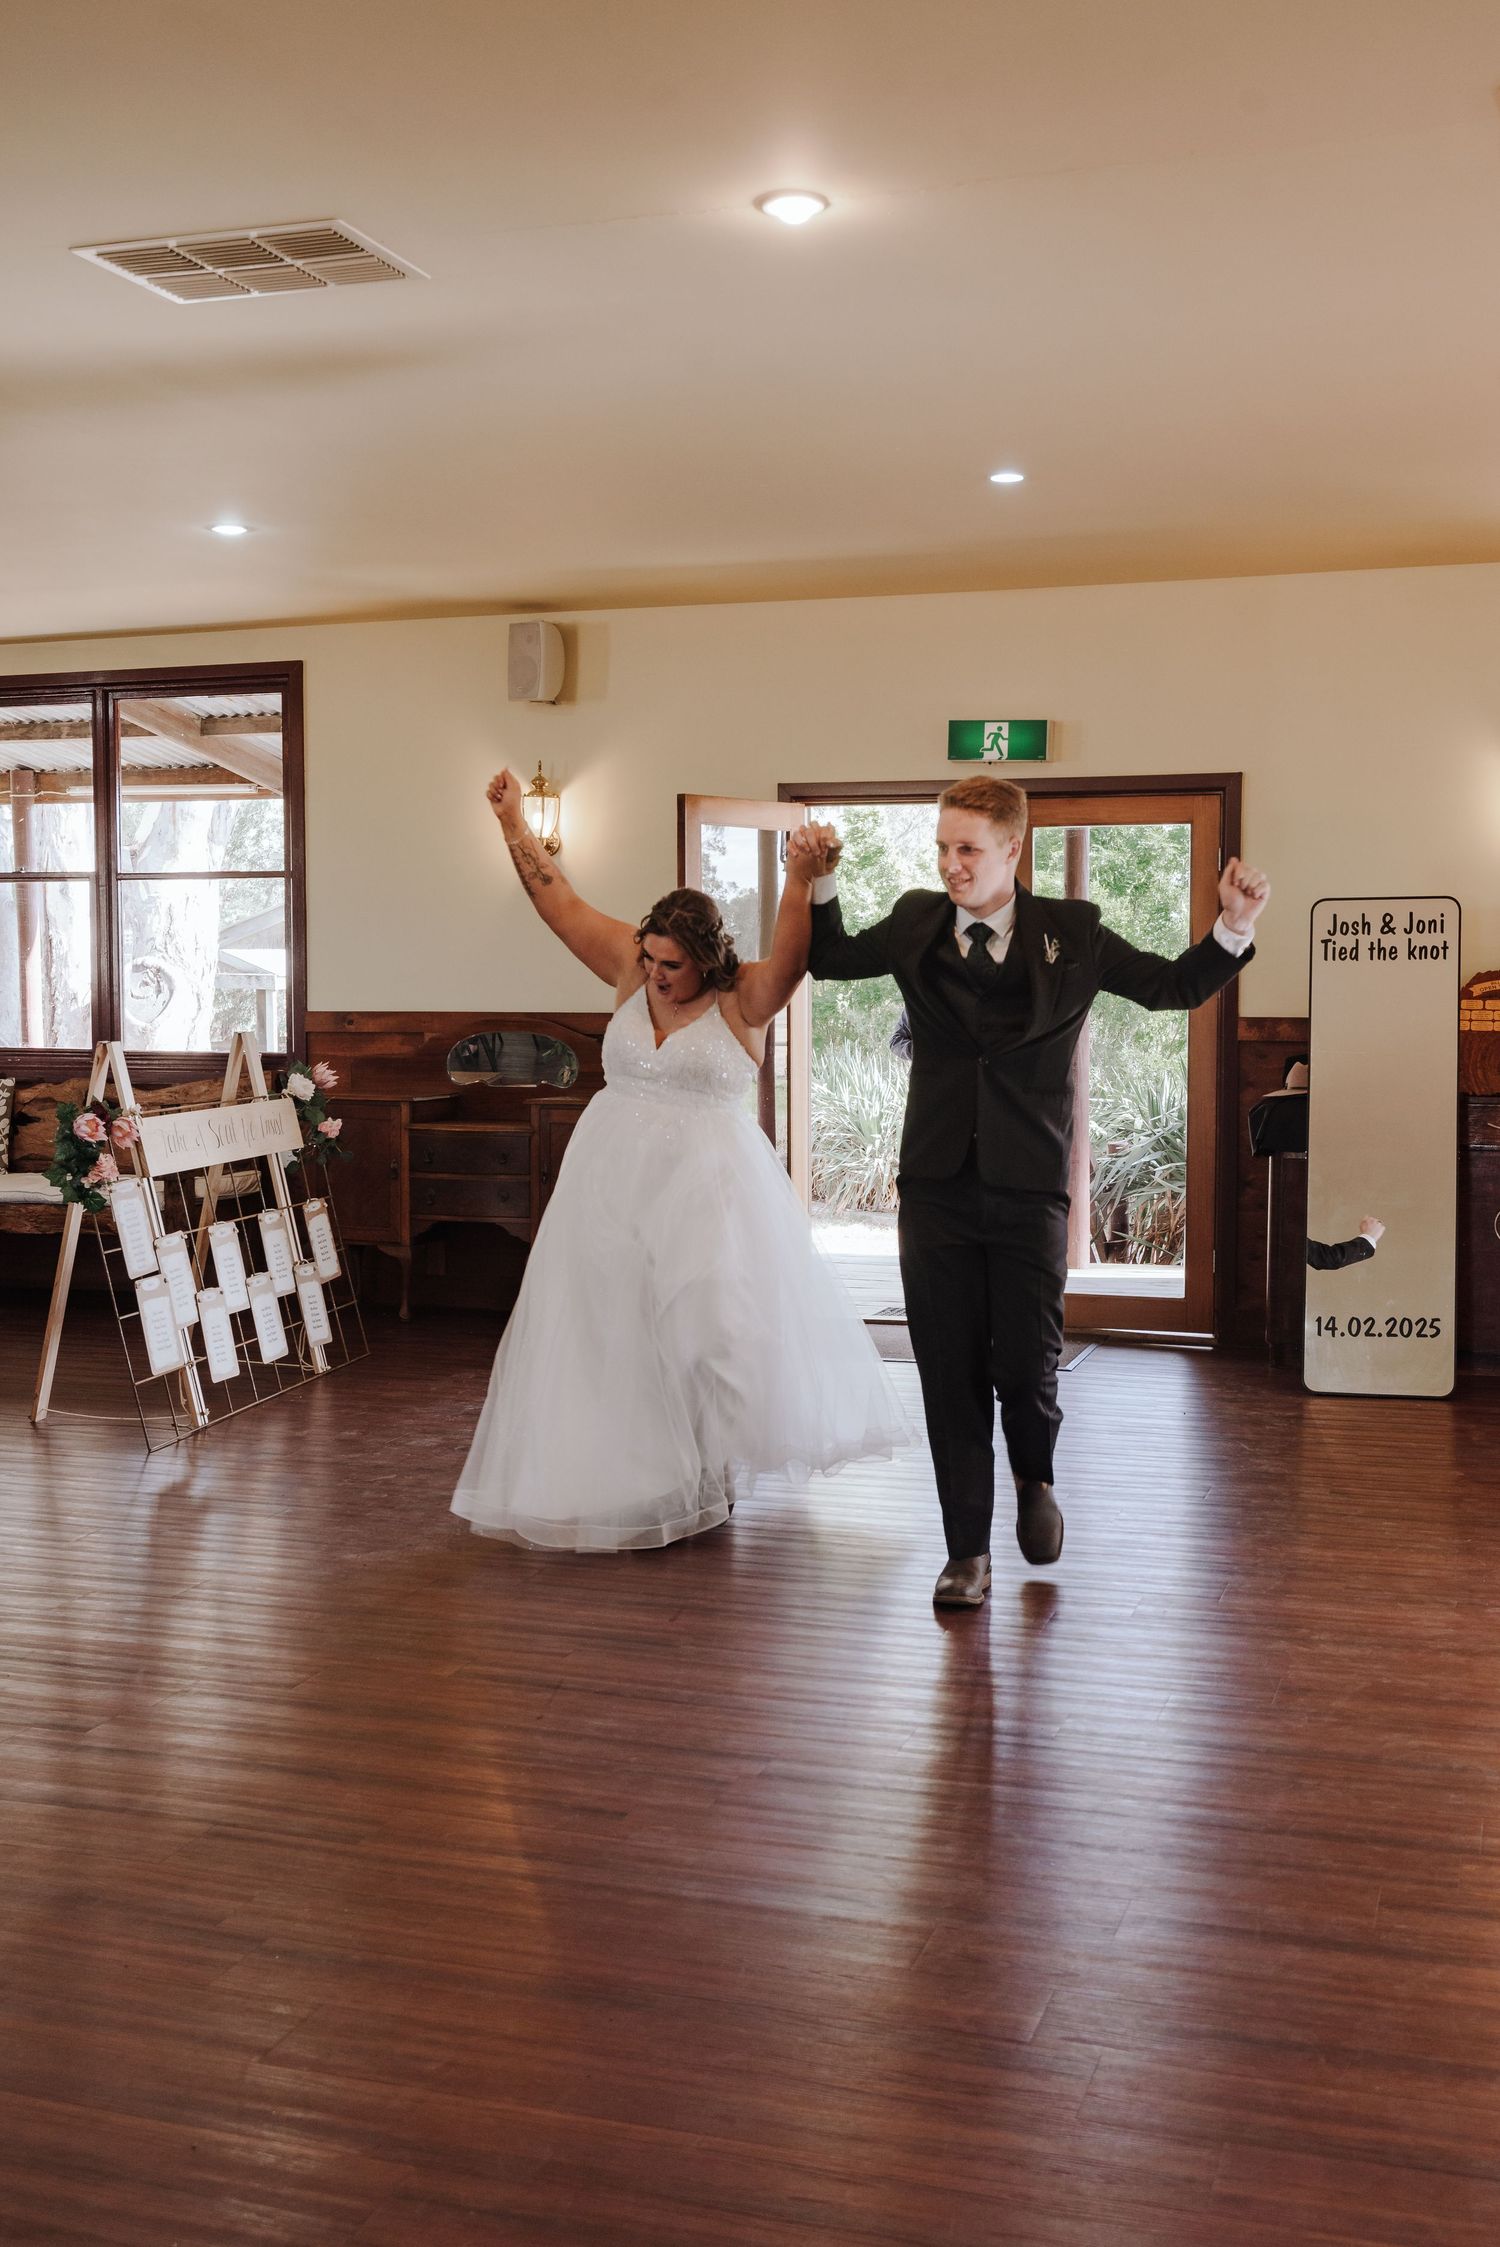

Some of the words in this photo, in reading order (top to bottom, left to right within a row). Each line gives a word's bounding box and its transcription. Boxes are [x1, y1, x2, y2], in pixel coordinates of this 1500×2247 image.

[1327, 912, 1371, 937] Josh
[1380, 912, 1397, 935] &
[1403, 911, 1446, 935] Joni
[1320, 938, 1359, 962] Tied
[1367, 938, 1399, 961] the
[1407, 937, 1449, 961] knot
[207, 1116, 238, 1149] Seat
[1315, 1315, 1441, 1338] 14.02.2025
